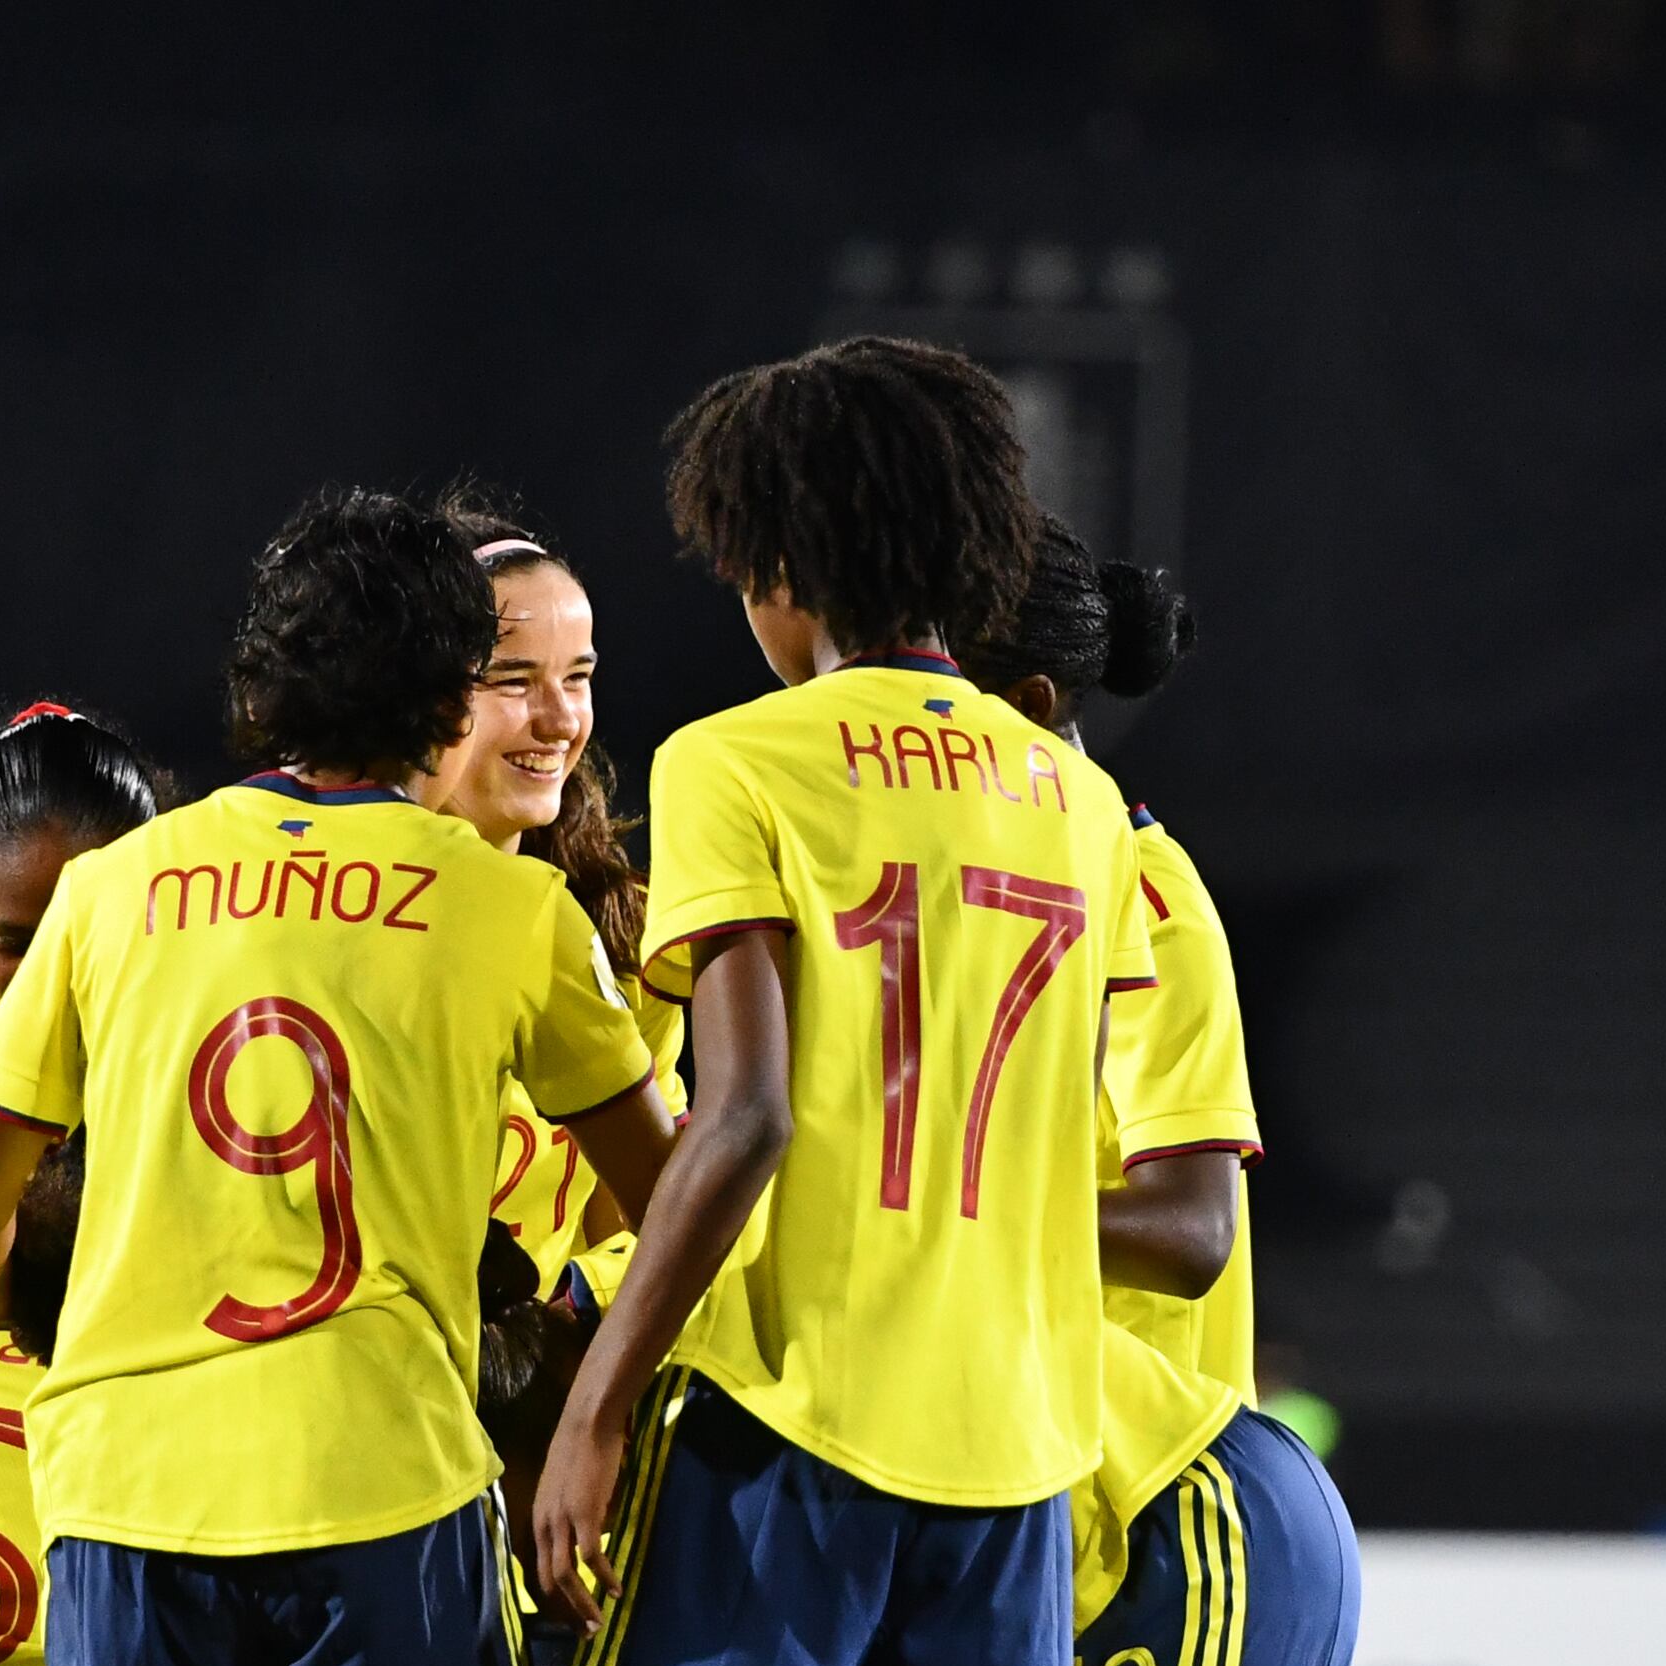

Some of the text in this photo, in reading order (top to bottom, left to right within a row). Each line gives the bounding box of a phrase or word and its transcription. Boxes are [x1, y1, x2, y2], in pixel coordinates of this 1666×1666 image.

[838, 721, 1067, 813] KARLA
[145, 850, 437, 935] MUÑOZ
[833, 861, 1086, 1220] 17
[187, 996, 361, 1343] 9
